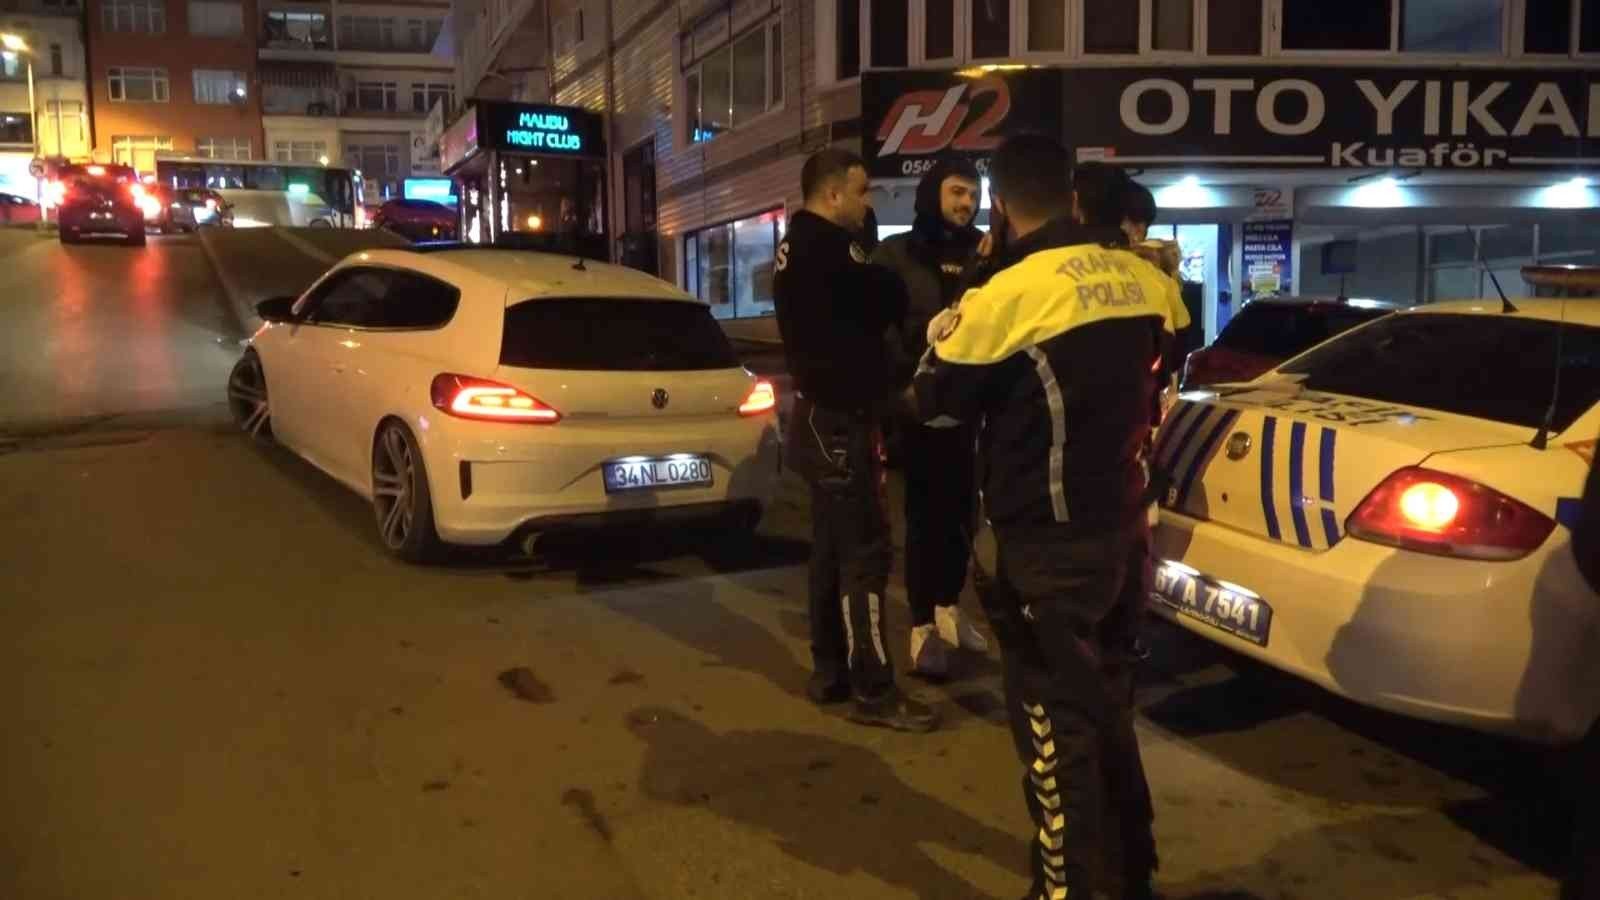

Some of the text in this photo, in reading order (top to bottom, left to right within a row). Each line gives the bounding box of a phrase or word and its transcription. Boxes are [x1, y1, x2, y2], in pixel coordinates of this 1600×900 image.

[1120, 78, 1325, 136] OTO
[506, 130, 581, 150] NIGHT CLUB
[1331, 143, 1507, 168] Kuaför
[776, 241, 790, 271] S
[1155, 565, 1180, 597] 67
[1182, 574, 1198, 607] A
[1204, 585, 1261, 632] 7541
